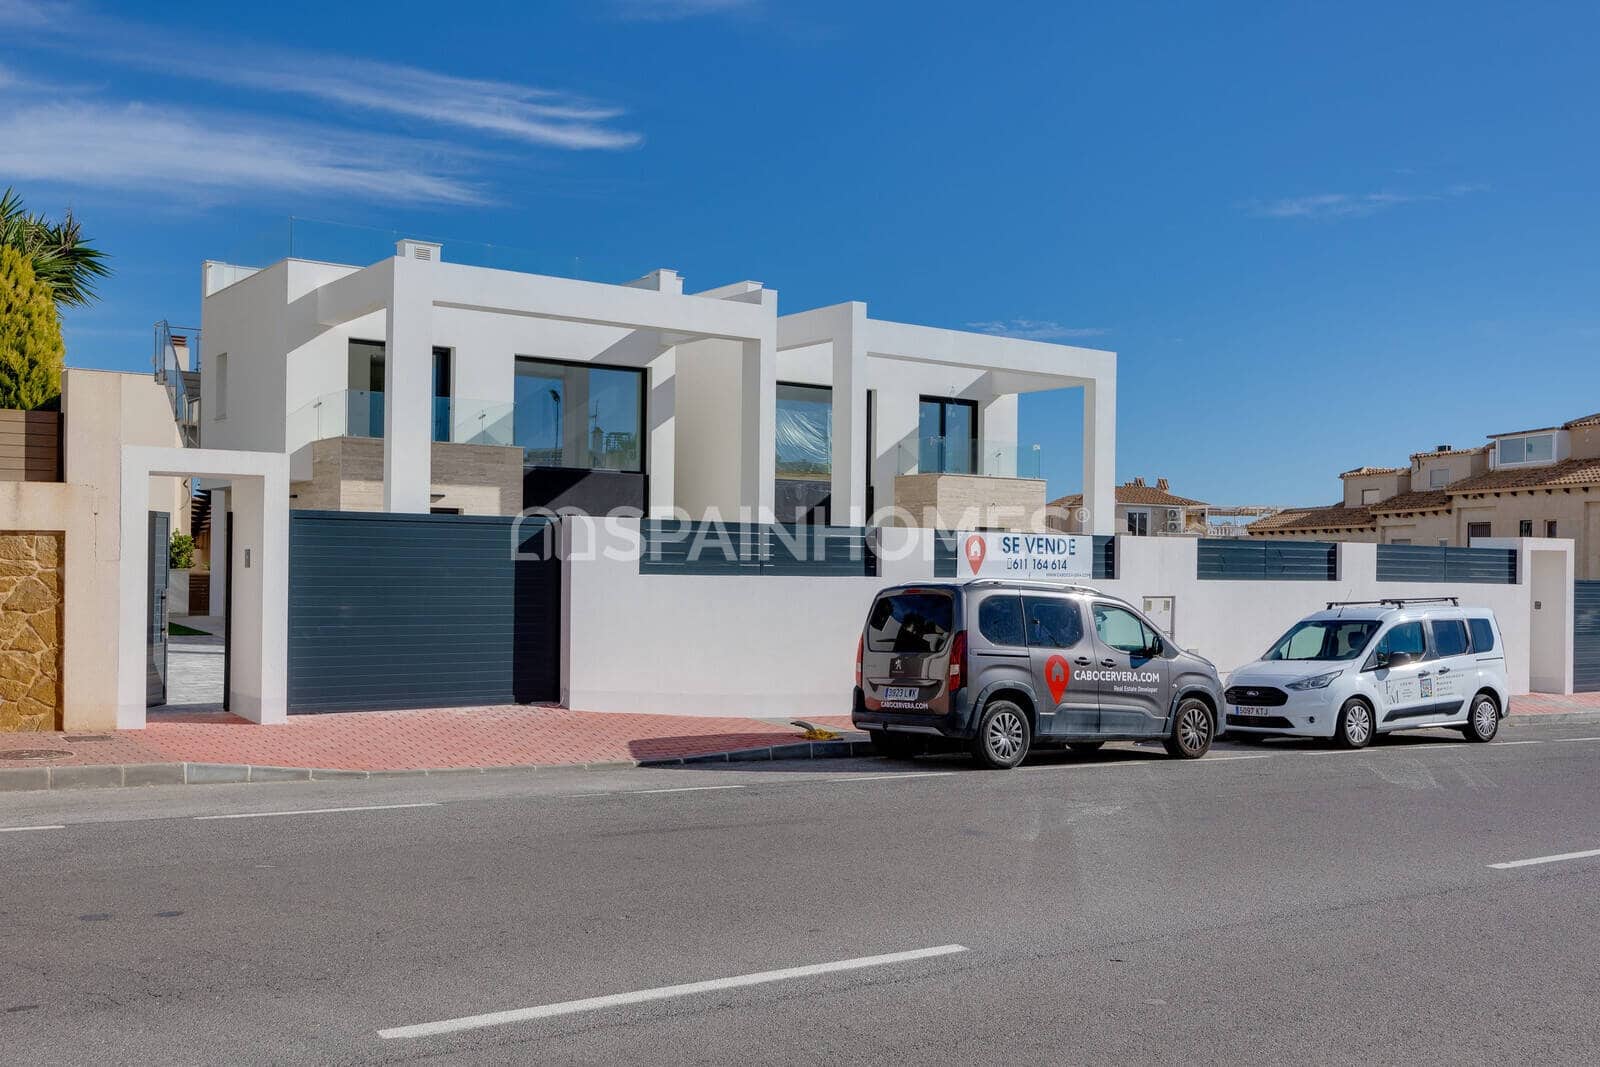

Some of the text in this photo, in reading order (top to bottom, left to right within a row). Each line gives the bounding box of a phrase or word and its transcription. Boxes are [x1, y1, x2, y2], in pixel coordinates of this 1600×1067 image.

[1002, 536, 1076, 555] SE VENDE
[1012, 558, 1068, 570] 611 164 614
[1074, 670, 1159, 682] CABOCERVERA.COM
